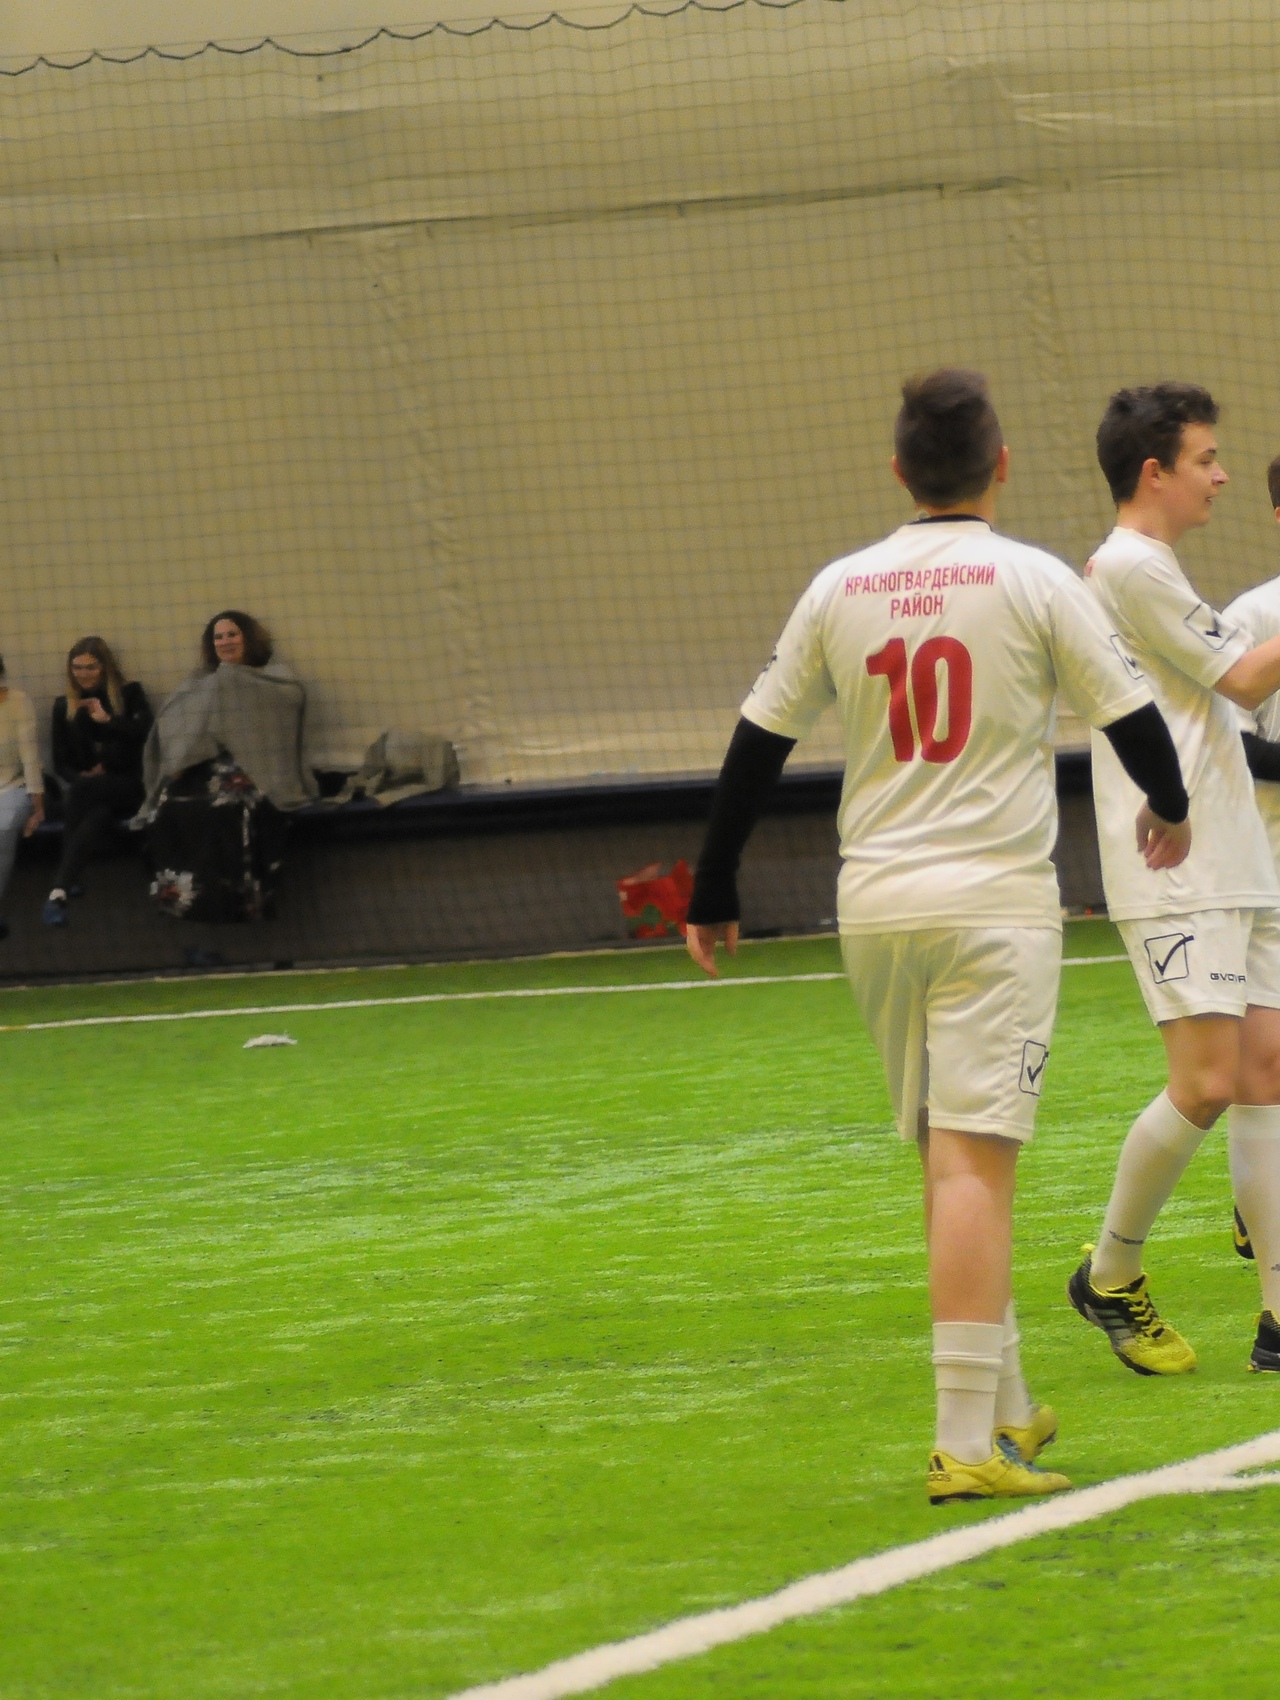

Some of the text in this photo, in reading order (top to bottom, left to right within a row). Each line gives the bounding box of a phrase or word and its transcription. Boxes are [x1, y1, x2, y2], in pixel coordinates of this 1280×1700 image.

[845, 563, 995, 596] КРАСНОГВАРДЕЙСКИЙ
[890, 593, 944, 619] РАЙОН
[865, 636, 973, 764] 10
